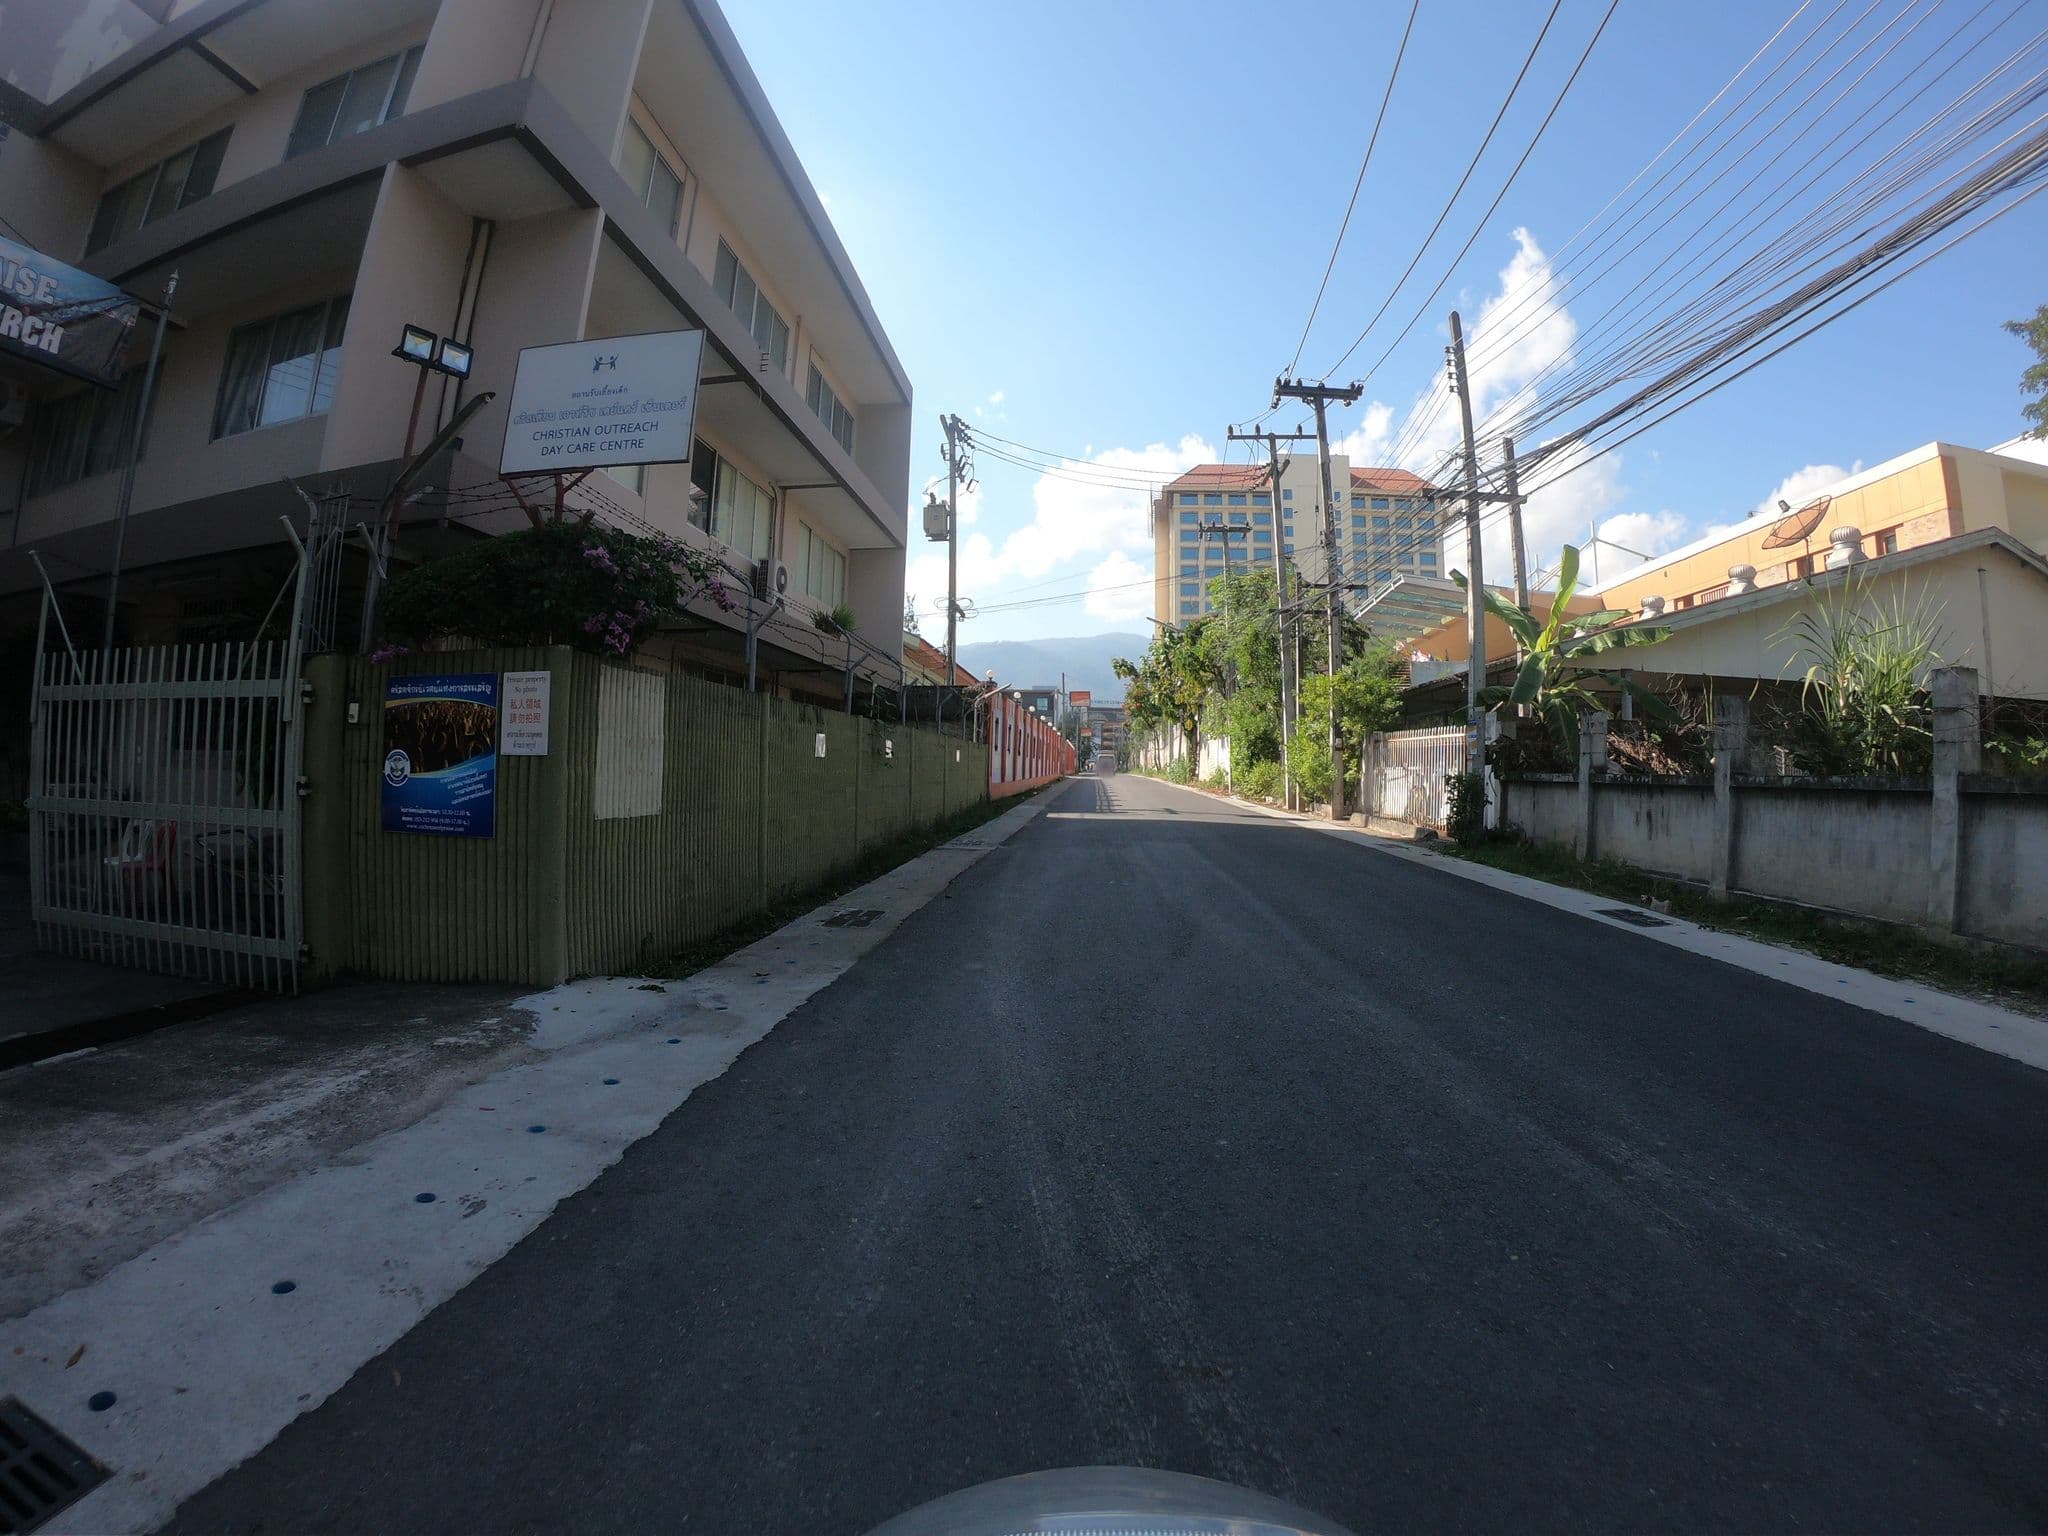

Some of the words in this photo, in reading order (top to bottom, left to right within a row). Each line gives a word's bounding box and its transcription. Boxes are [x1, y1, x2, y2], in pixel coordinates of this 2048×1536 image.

[532, 426, 591, 441] CHRISTIAN
[594, 420, 659, 436] OUTREACH
[540, 444, 563, 457] DAY
[566, 442, 596, 454] CARE
[600, 438, 645, 451] CENTRE
